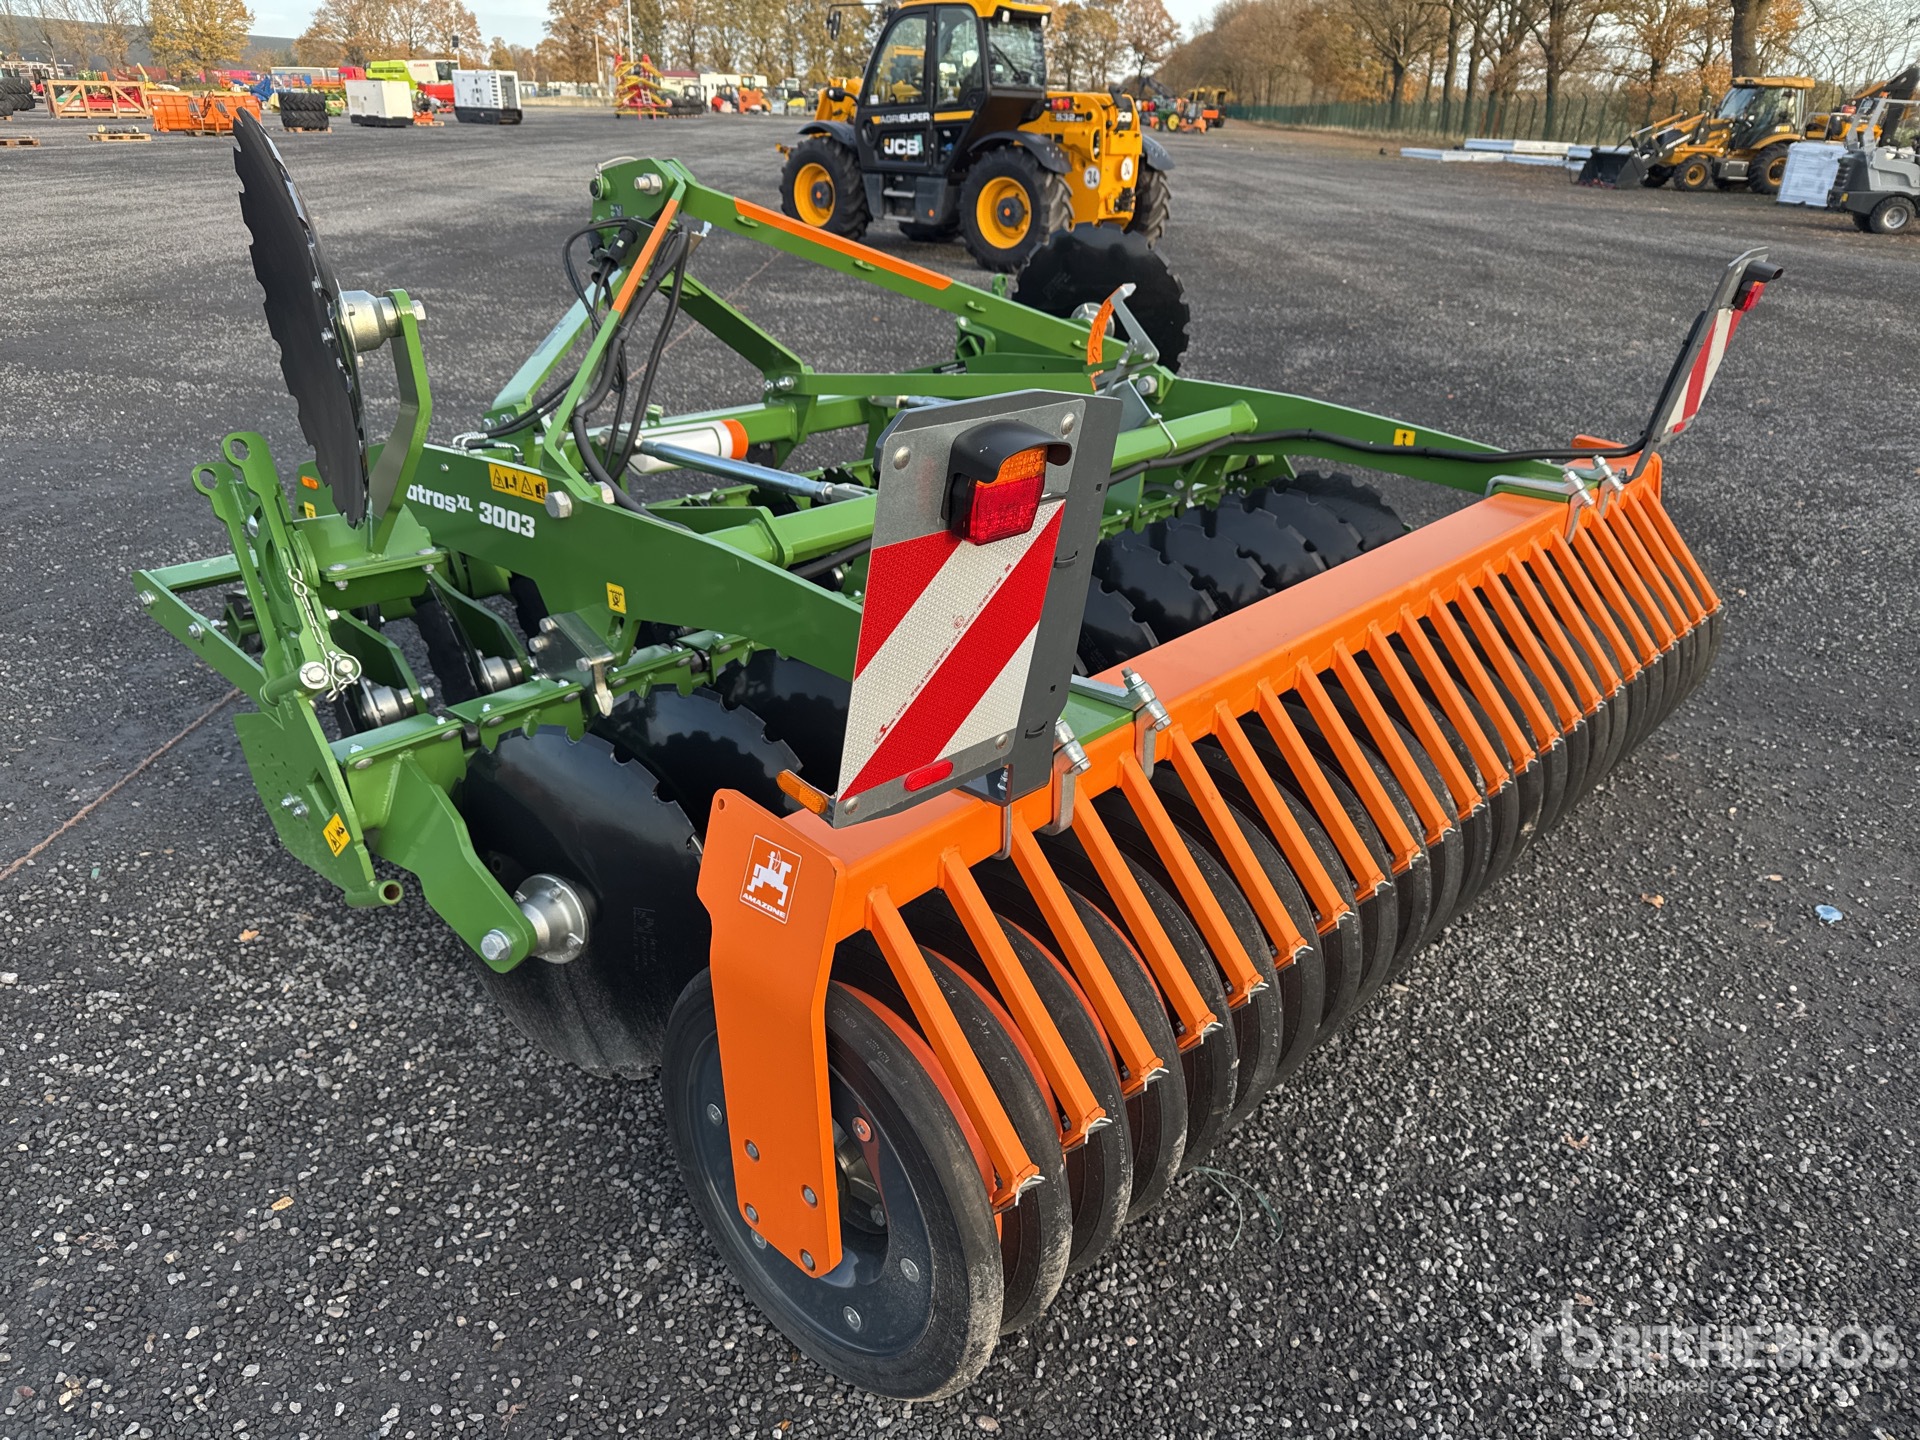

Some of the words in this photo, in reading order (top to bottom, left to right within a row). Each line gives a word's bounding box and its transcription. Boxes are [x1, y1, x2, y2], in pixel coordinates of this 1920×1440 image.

[883, 137, 920, 156] JCB
[479, 501, 536, 539] 3003
[742, 892, 786, 918] AMAZONE
